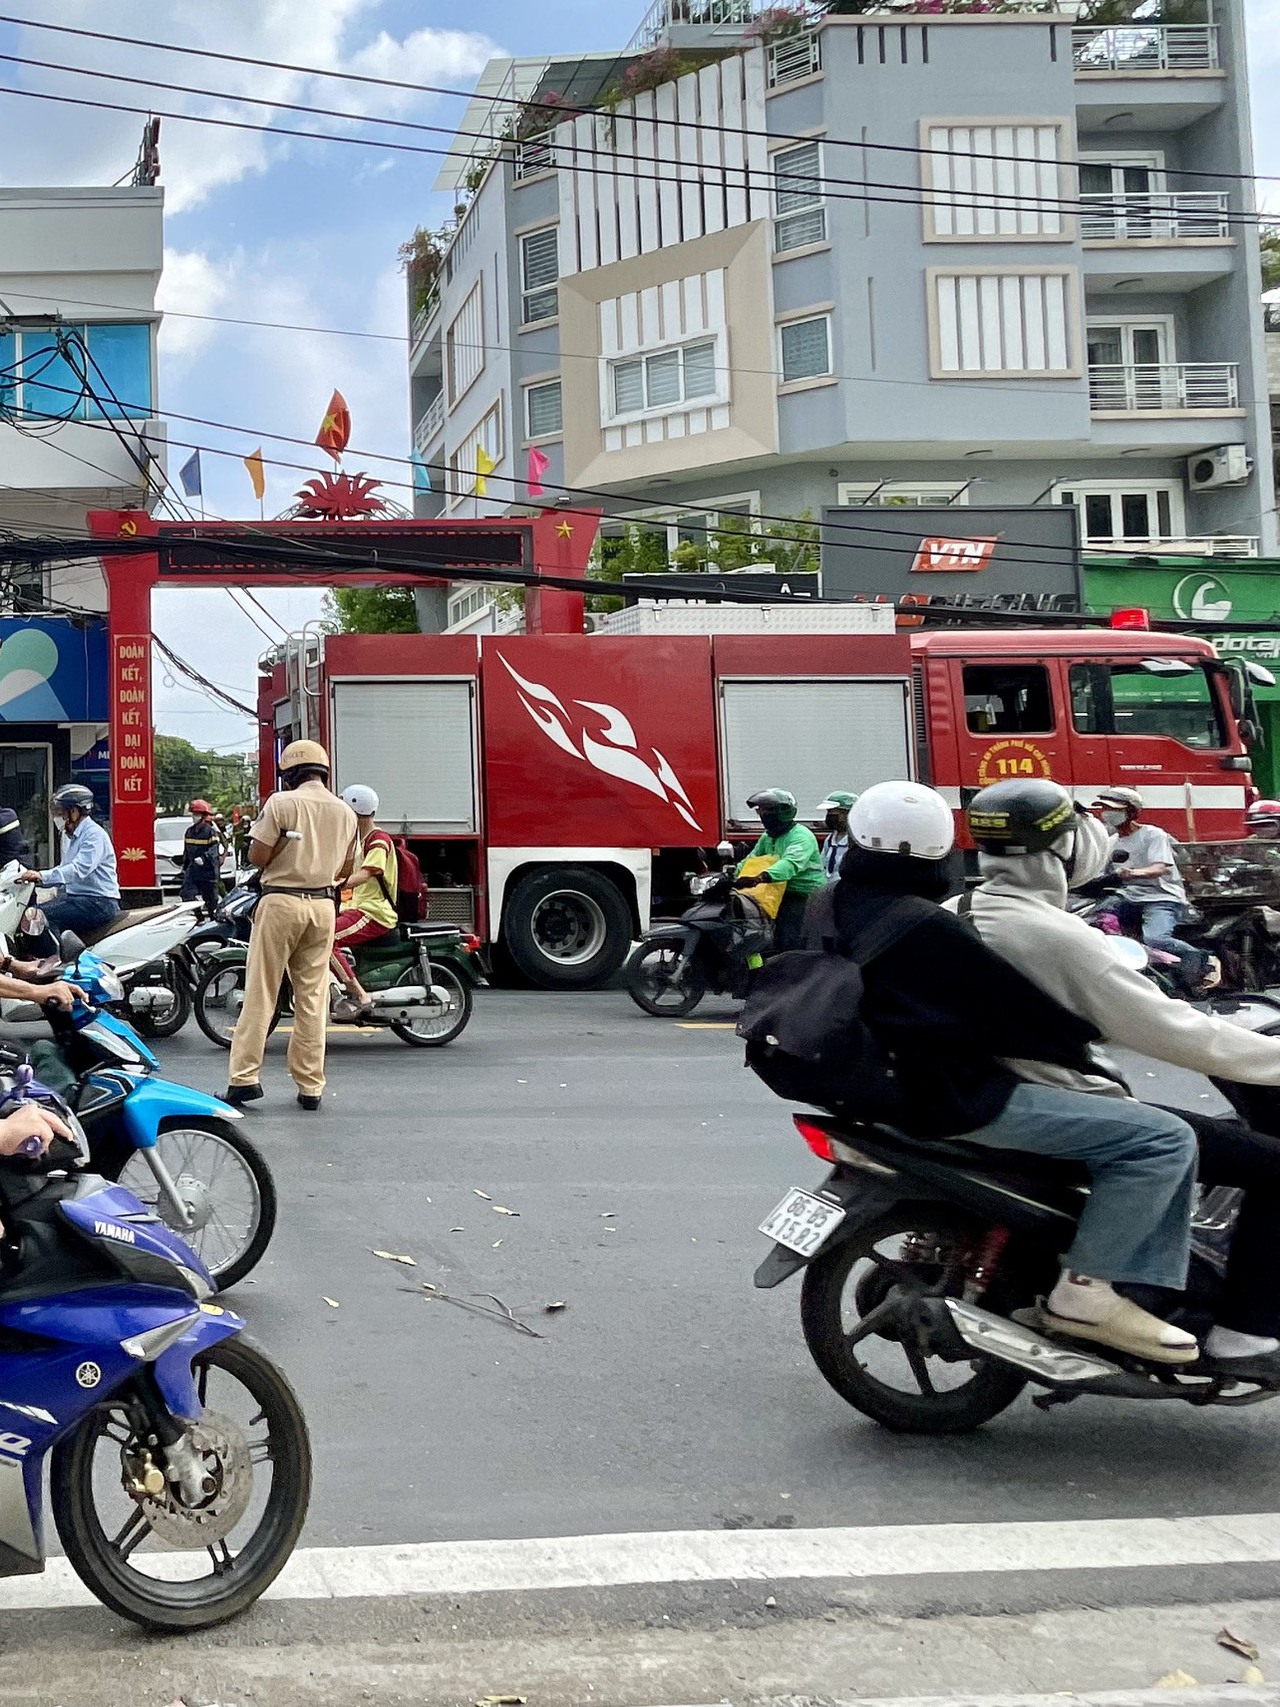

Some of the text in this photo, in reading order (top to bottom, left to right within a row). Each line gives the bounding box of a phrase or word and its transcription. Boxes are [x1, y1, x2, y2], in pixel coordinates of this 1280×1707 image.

[929, 543, 986, 565] VTN
[120, 642, 144, 659] ĐOÀN
[120, 686, 145, 703] ĐOÀN
[124, 734, 140, 750] ĐẠI
[120, 752, 146, 769] ĐOÀN
[996, 758, 1034, 774] 114
[124, 773, 142, 791] KẾT
[94, 1220, 135, 1244] YAMAHA
